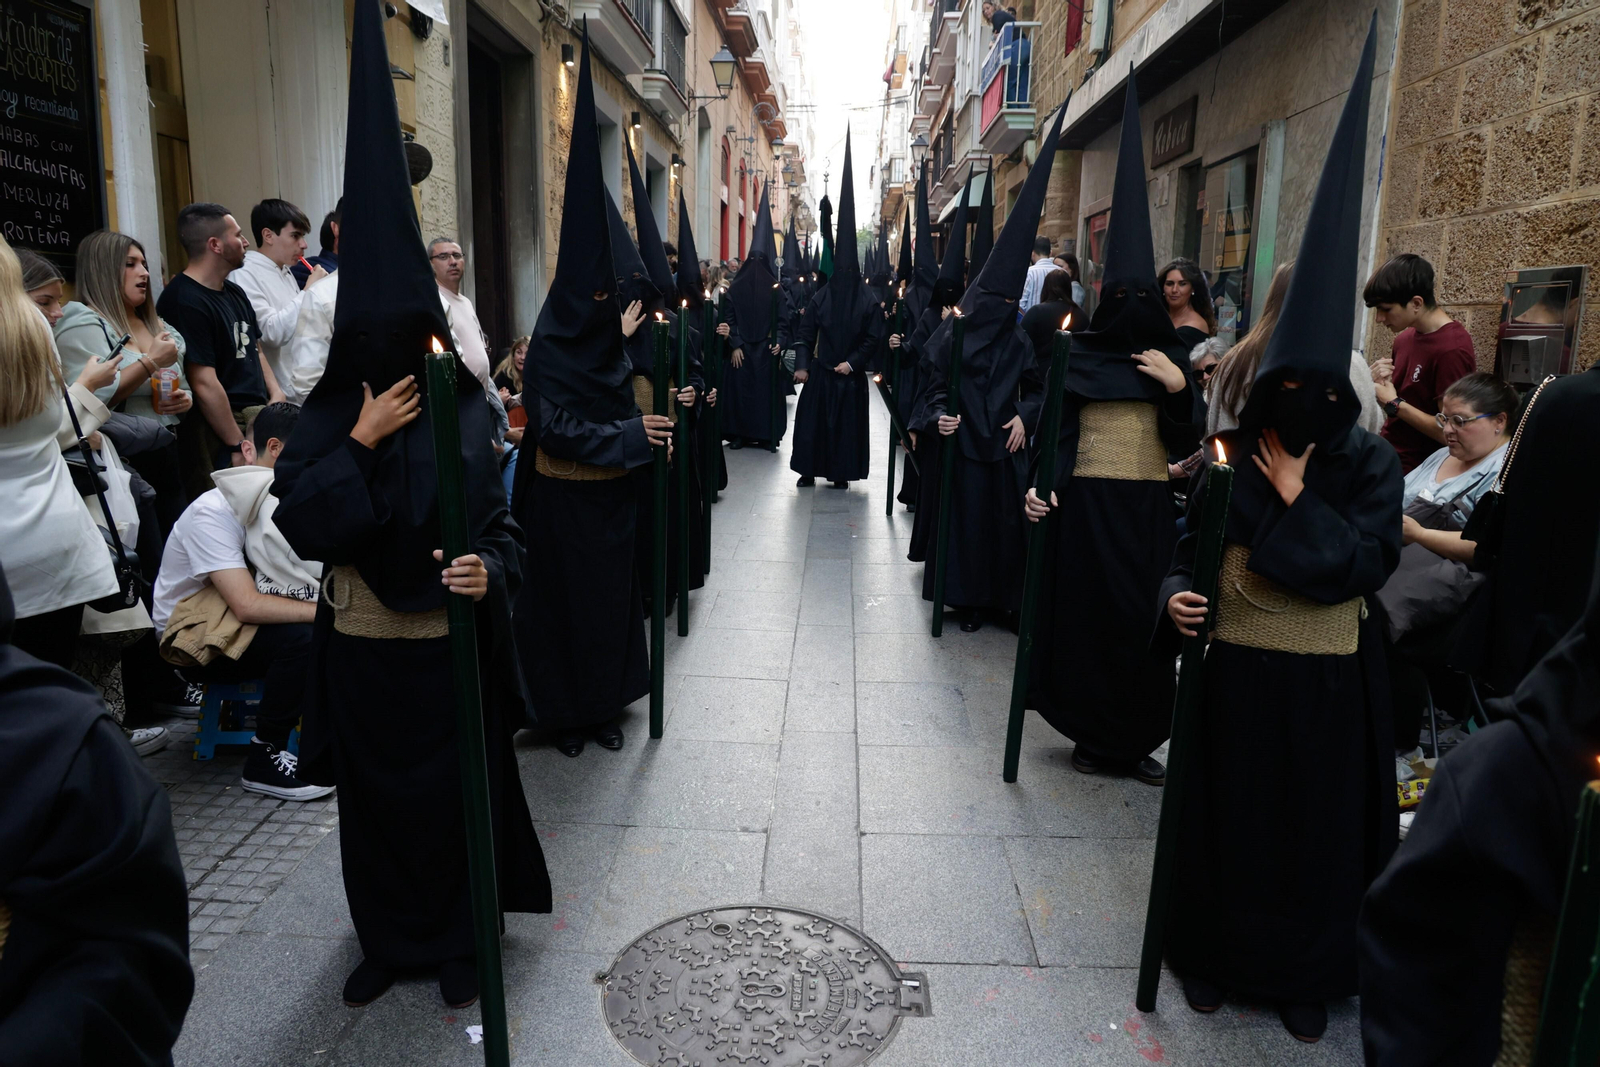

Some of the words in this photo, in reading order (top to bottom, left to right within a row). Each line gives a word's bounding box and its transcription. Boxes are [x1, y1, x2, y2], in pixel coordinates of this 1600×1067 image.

[57, 29, 73, 65] de
[0, 88, 18, 119] oy
[50, 140, 73, 153] CON
[0, 148, 87, 190] ALCACHOFAS
[3, 182, 70, 211] MERLUZA
[34, 210, 42, 220] A
[49, 212, 63, 224] LA
[3, 220, 71, 247] ROTEÑA
[809, 953, 845, 1034] SANEAMIENTO
